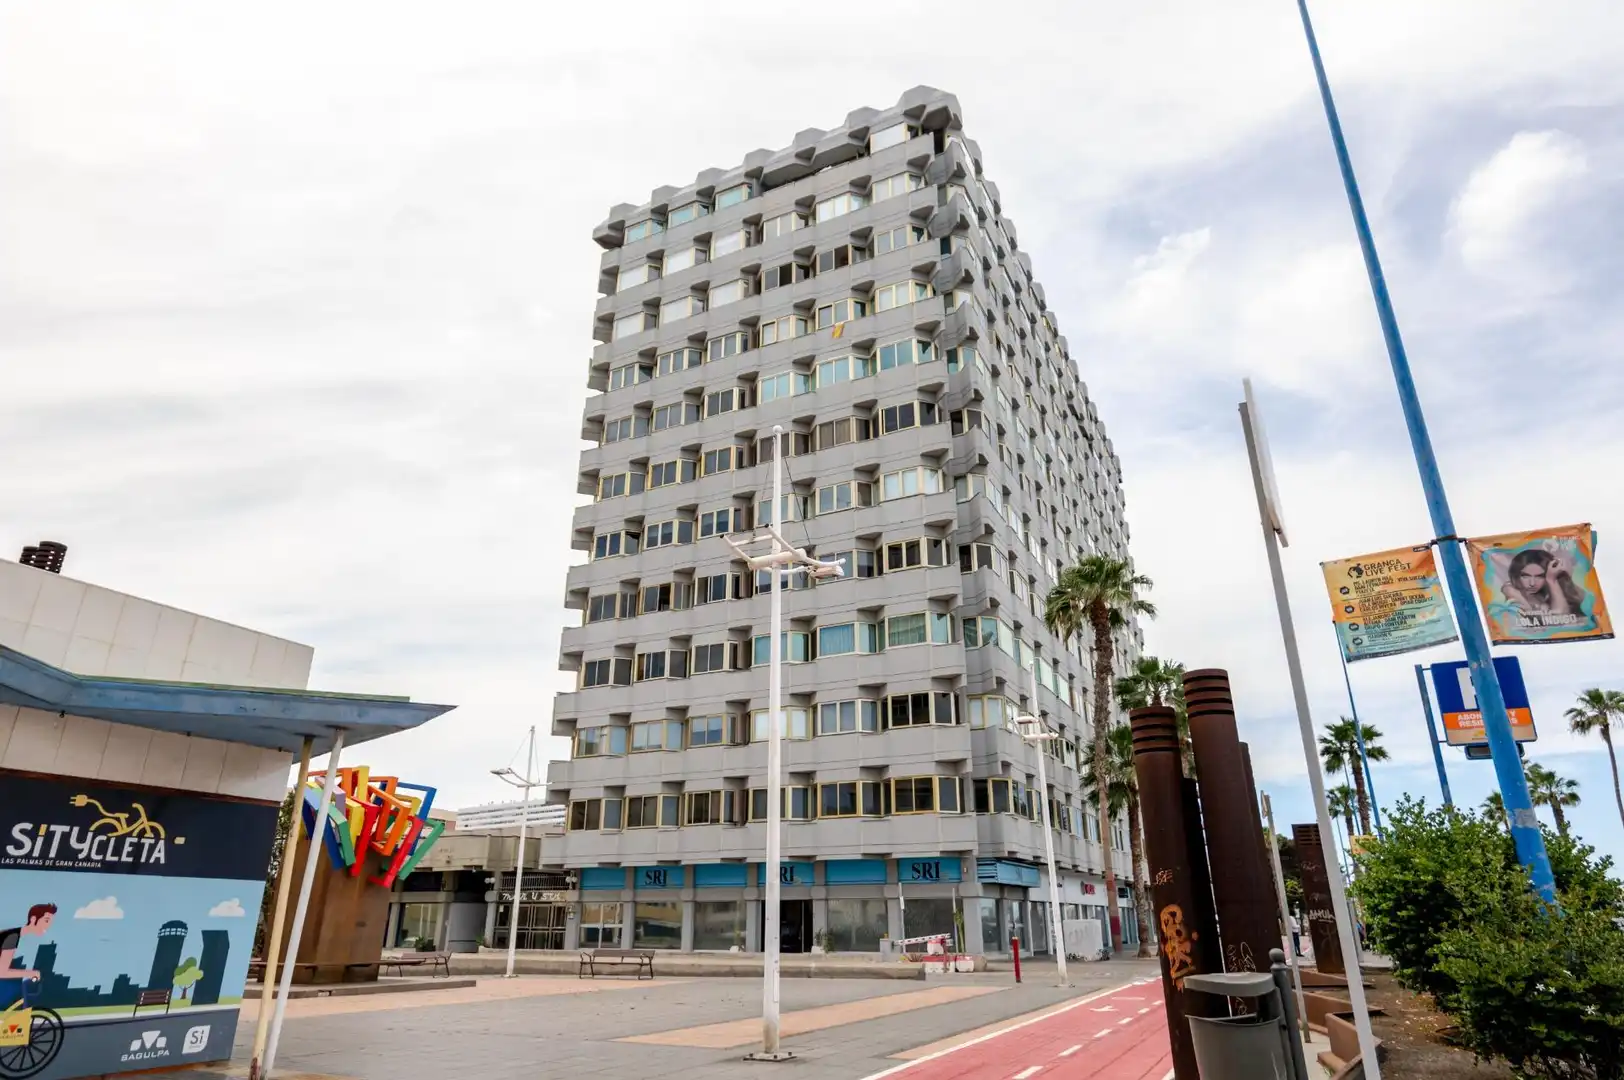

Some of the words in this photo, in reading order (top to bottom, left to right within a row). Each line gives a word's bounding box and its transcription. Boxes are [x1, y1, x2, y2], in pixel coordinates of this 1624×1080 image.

[1364, 559, 1402, 571] GRANCA
[1365, 568, 1384, 577] LIVE
[1388, 562, 1412, 573] FEST
[1516, 617, 1541, 627] LOLA
[1541, 613, 1577, 626] INDIGO
[645, 868, 667, 886] SRI
[780, 865, 795, 884] RI
[912, 861, 940, 880] SRI
